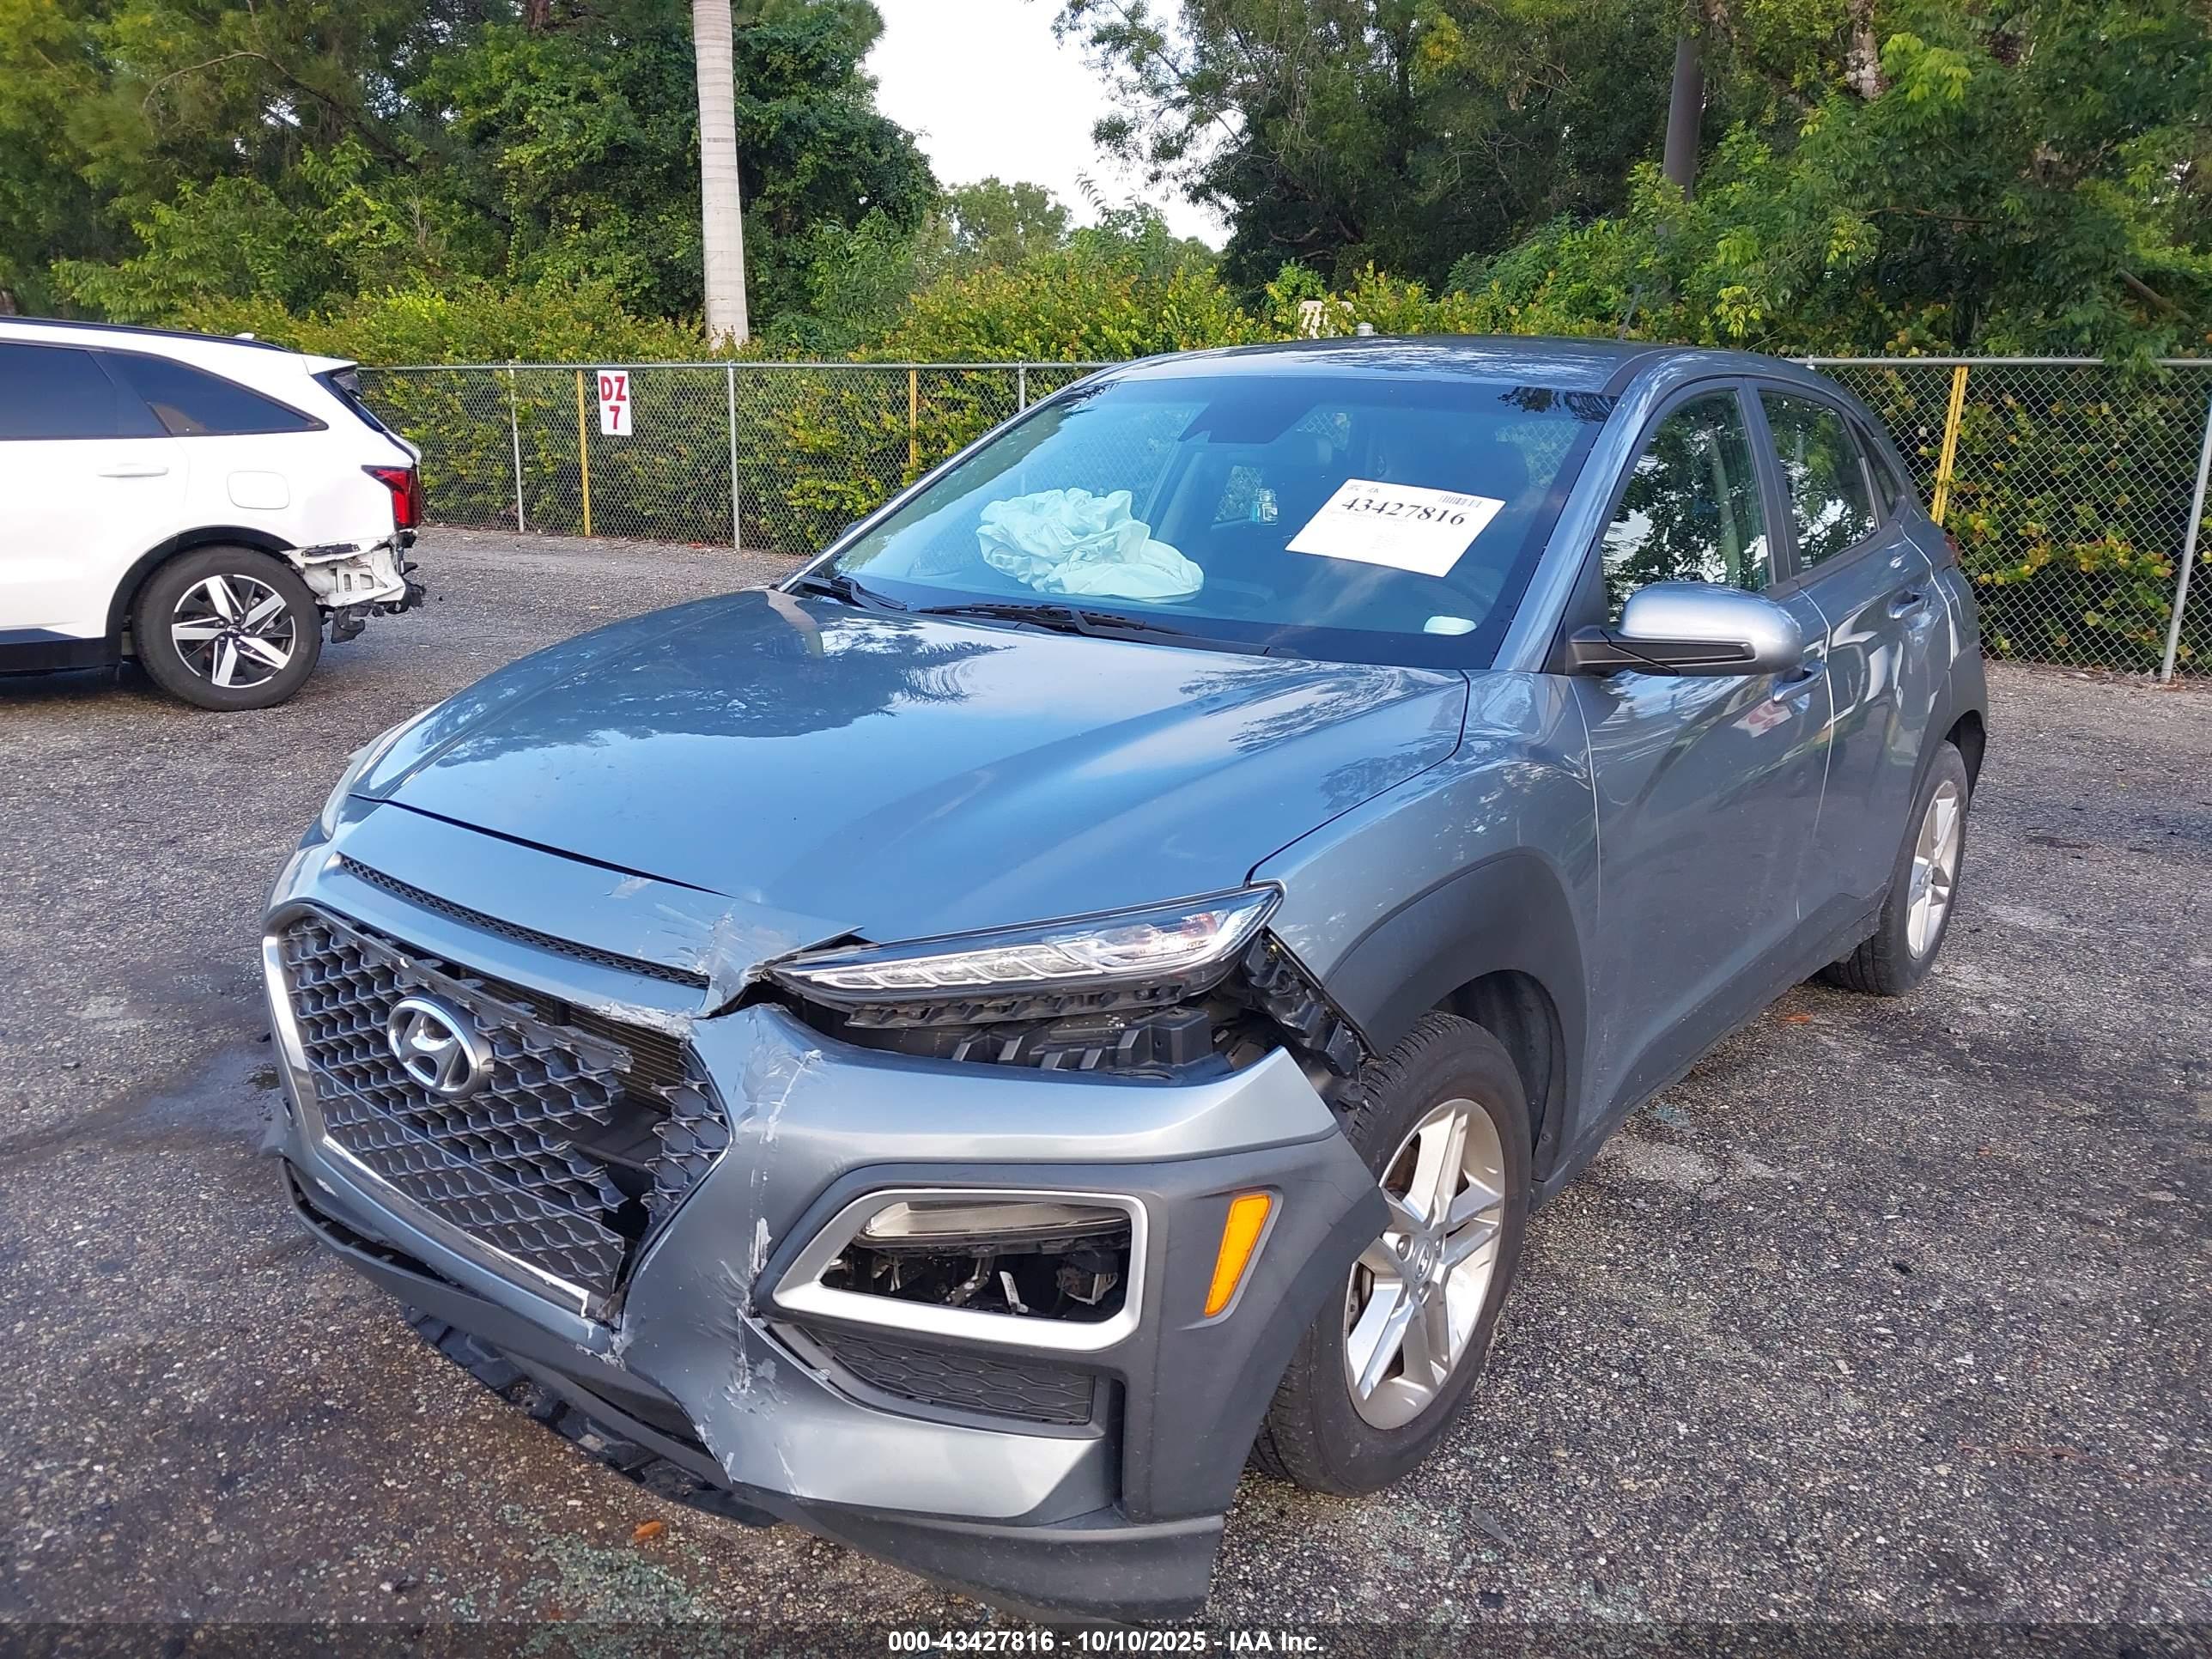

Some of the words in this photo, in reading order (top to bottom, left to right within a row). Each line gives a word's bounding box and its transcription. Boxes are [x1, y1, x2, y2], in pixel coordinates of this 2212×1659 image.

[600, 376, 627, 401] DZ
[609, 405, 621, 429] 7
[1341, 496, 1470, 526] 43427816
